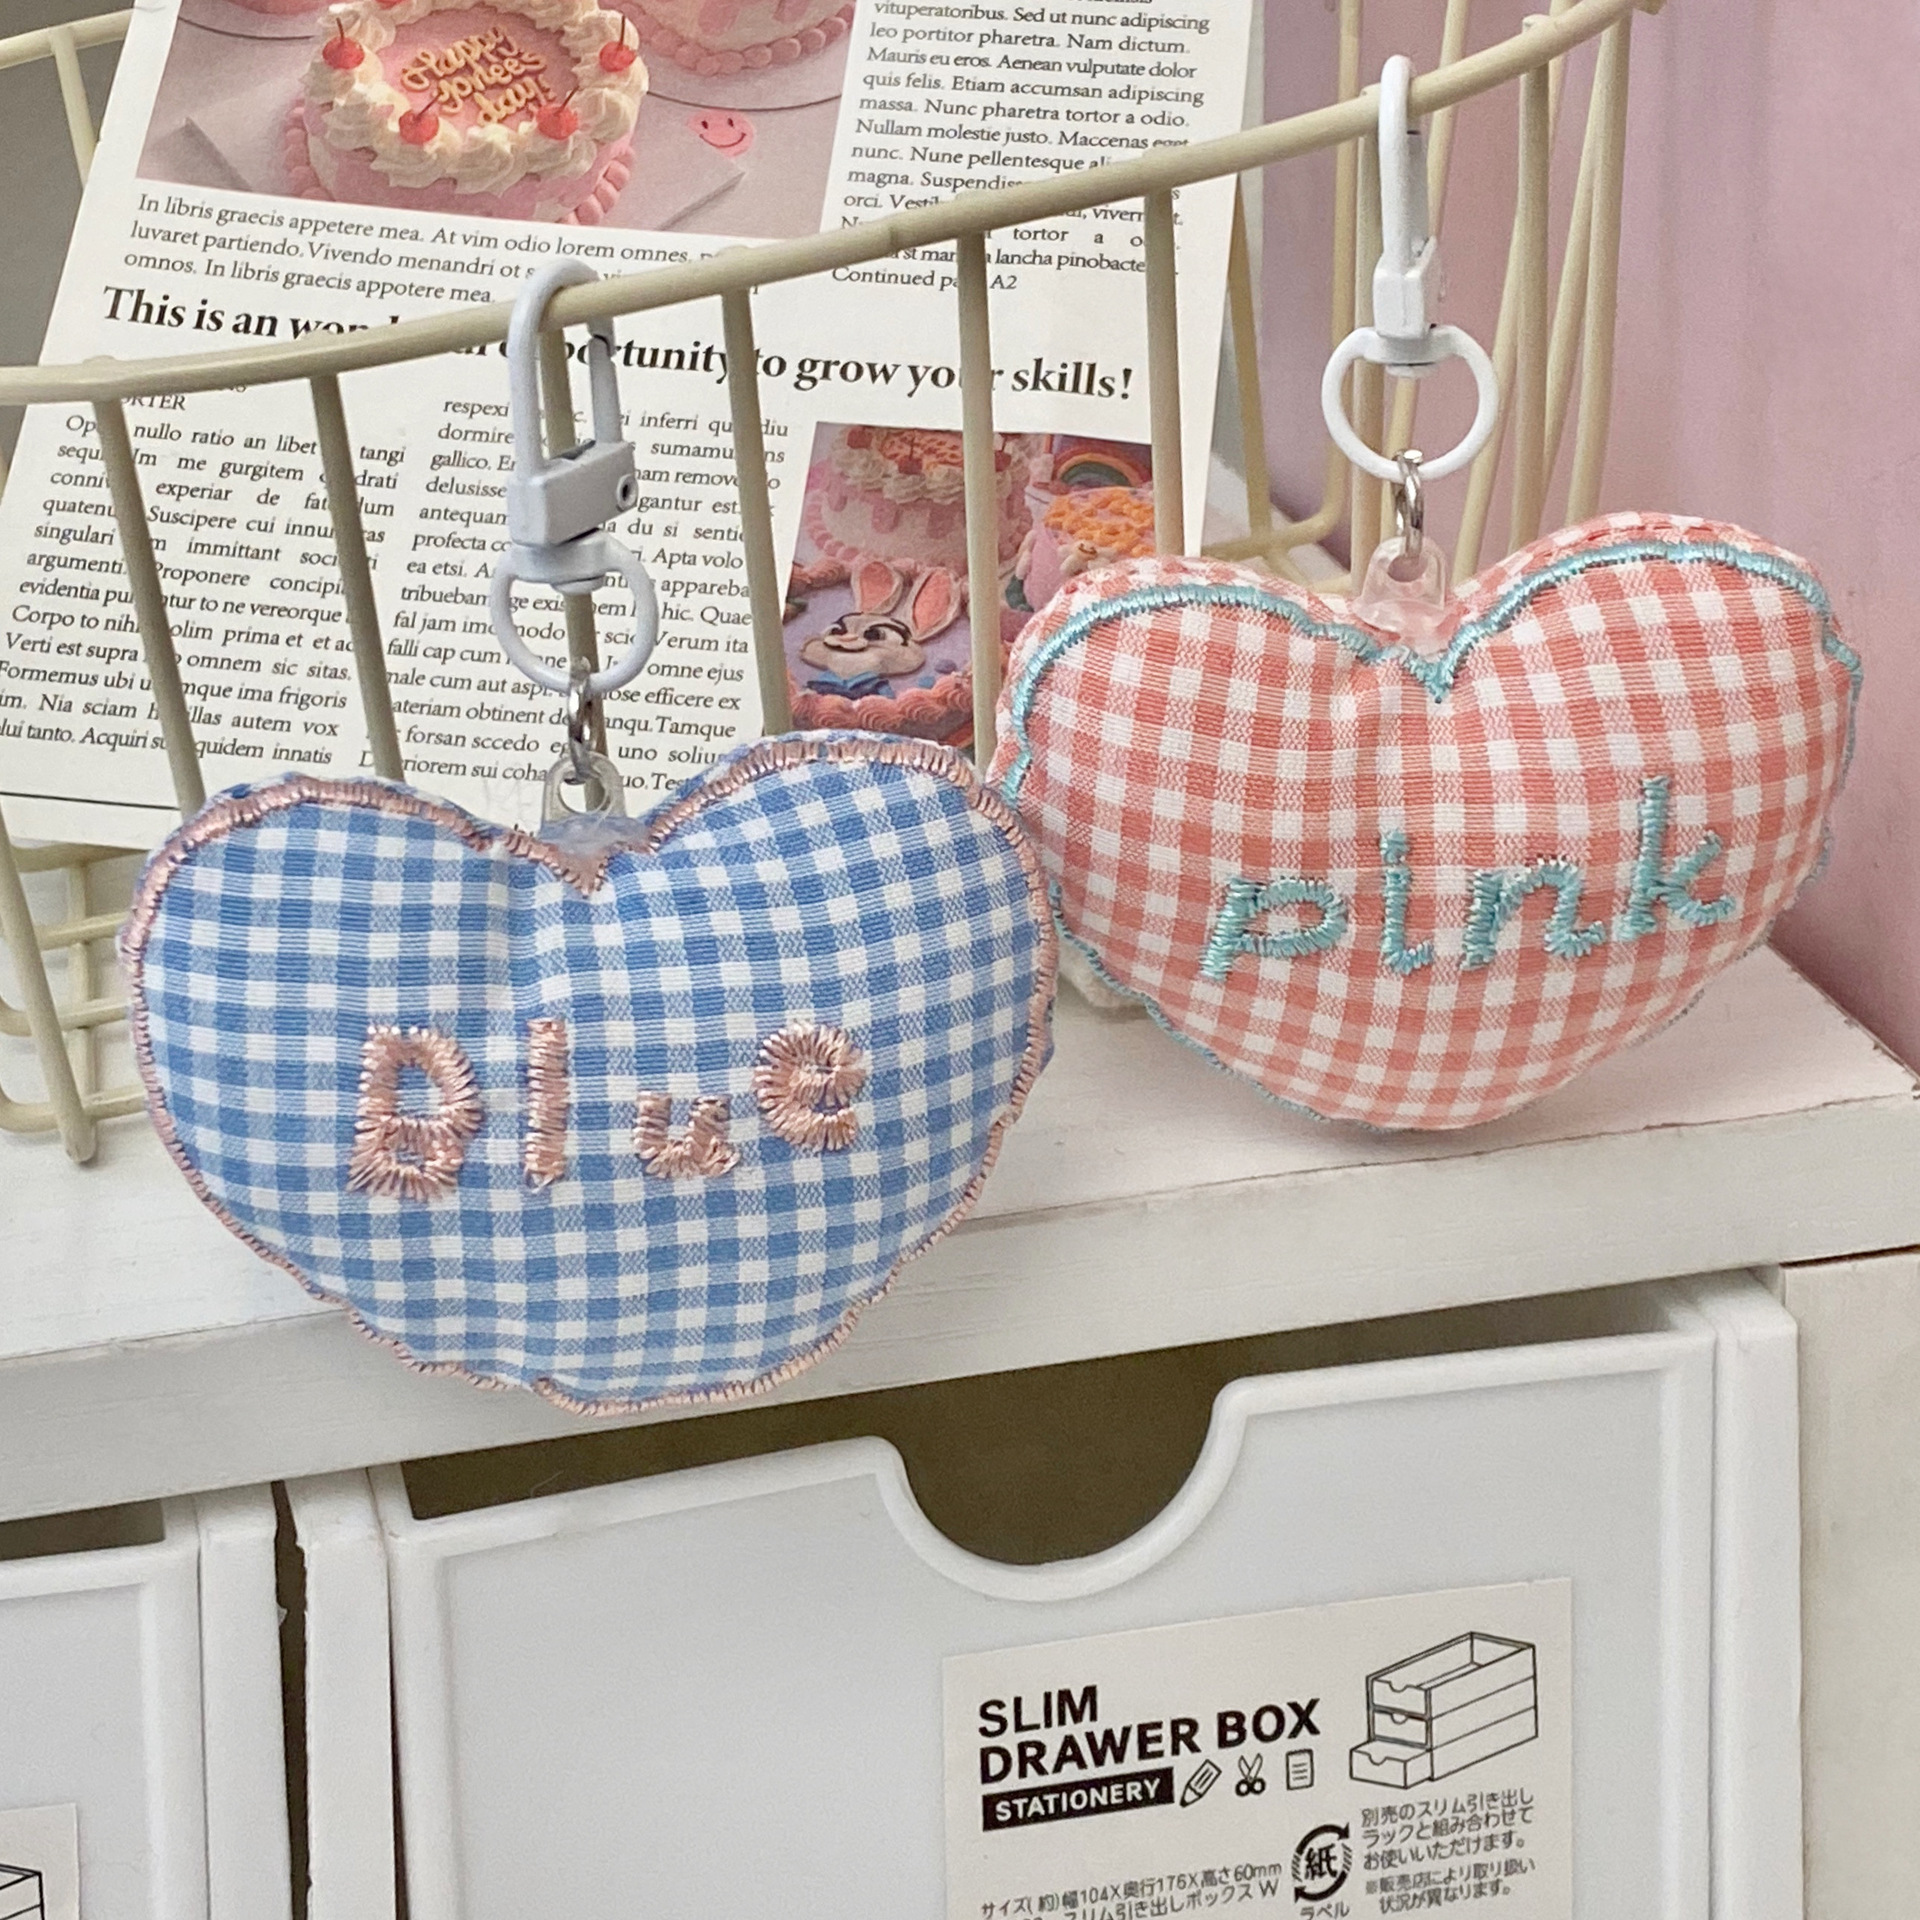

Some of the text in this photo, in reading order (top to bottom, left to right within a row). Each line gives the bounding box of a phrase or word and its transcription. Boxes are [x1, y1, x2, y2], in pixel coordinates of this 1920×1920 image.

[870, 22, 1190, 54] leo portitor pharetra. Nam dictum.
[1013, 7, 1045, 24] Sed
[1050, 12, 1067, 25] ut
[1071, 14, 1117, 27] nunc
[1121, 14, 1210, 34] adipiscing
[867, 47, 1197, 79] Mauris eu eros. Aenean vulputate dolor
[863, 73, 1204, 107] quis felis. Etiam accumsan adipiscing
[859, 98, 1190, 128] massa. Nunc pharetra tortor a odio.
[855, 118, 922, 138] Nullam
[927, 122, 1000, 142] molestie
[1002, 127, 1052, 146] justo.
[1059, 131, 1148, 149] Maccenas
[852, 146, 902, 160] nunc.
[910, 146, 963, 164] Nune
[968, 149, 1085, 173] pellentesque
[848, 170, 914, 188] magna.
[844, 194, 882, 208] orci.
[138, 194, 159, 212] In
[164, 196, 213, 219] libris
[216, 210, 284, 226] graecis
[289, 215, 373, 238] appetere
[379, 226, 424, 242] mea.
[430, 227, 456, 244] At
[461, 230, 498, 249] vim
[505, 236, 551, 252] odio
[556, 237, 614, 259] lorem
[620, 248, 692, 263] omnes.
[1013, 228, 1103, 243] tortor a
[203, 233, 304, 258] partiendo.
[309, 242, 392, 267] Vivendo
[398, 254, 494, 276] menandri
[500, 264, 520, 279] ot
[995, 249, 1053, 267] lancha
[124, 253, 496, 304] omnos. In libris graecis appotere mea.
[832, 266, 1017, 289] Continued A2
[103, 285, 186, 328] This
[192, 299, 225, 332] is
[232, 311, 278, 337] an
[793, 355, 901, 391] grow
[907, 364, 1005, 398] yor
[1011, 357, 1133, 399] skills!
[640, 411, 699, 430] inferri
[133, 423, 406, 467] nullo ratio an tangi
[430, 450, 492, 470] gallico.
[177, 456, 207, 471] me
[218, 459, 304, 482] gurgitem
[156, 482, 280, 506] experiar de
[148, 505, 276, 533] Suscipere cui
[627, 518, 679, 538] du si
[34, 522, 281, 562] singulari immittant
[412, 533, 697, 570] profecta Apta
[27, 552, 128, 575] argumenti.
[407, 560, 467, 577] ea etsi.
[20, 577, 342, 626] evidentia to ne vereorque
[661, 602, 752, 625] hic. Quae
[12, 605, 75, 630] Corpo
[80, 614, 99, 629] to
[222, 626, 279, 646] prima
[286, 633, 303, 648] et
[313, 636, 331, 650] et
[393, 610, 417, 628] fal
[418, 613, 456, 634] jam
[726, 635, 749, 653] ita
[6, 632, 351, 680] Verti est supra omnem sic sitas.
[387, 639, 744, 685] falli cap cum omne ejus
[104, 671, 136, 690] ubi
[238, 683, 273, 703] ima
[278, 686, 347, 710] frigoris
[430, 674, 472, 690] cum
[477, 679, 507, 692] aut
[645, 687, 713, 708] efficere
[718, 697, 741, 710] ex
[39, 693, 340, 736] Nia sciam autem vox
[466, 702, 736, 742] obtinent Tamque
[27, 724, 332, 764] tanto. Acquiri innatis
[405, 724, 658, 761] forsan sccedo uno
[471, 761, 499, 778] sui
[978, 1685, 1098, 1738] SLIM
[979, 1698, 1321, 1785] DRAWER BOX
[995, 1778, 1162, 1822] STATIONERY
[1361, 1788, 1534, 1827] 別売のスリム引き出し
[1364, 1807, 1534, 1848] ラックと組み合わせて
[1305, 1843, 1337, 1880] 紙
[1364, 1830, 1525, 1871] お使いいただけます。
